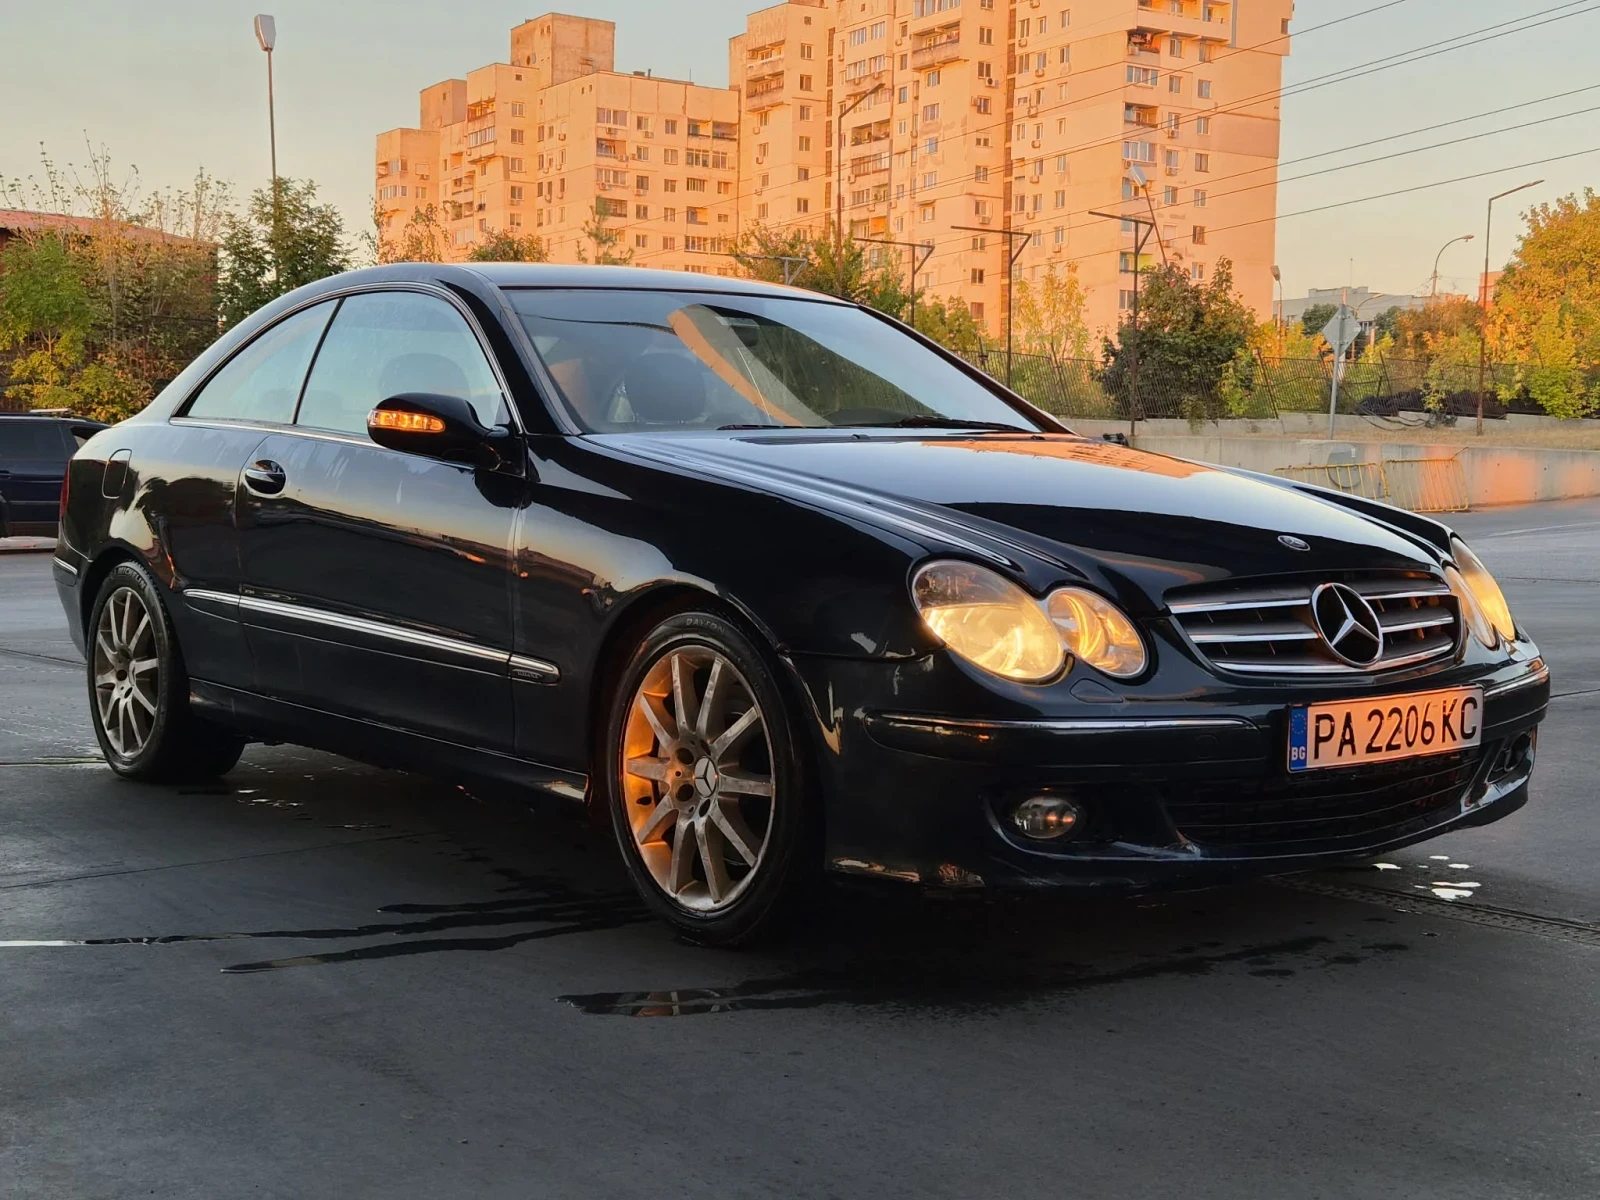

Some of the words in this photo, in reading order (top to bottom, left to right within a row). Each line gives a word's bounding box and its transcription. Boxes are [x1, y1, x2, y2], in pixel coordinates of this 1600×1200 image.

[117, 566, 147, 589] MICHELIN
[686, 618, 725, 633] DAYTON
[1313, 711, 1357, 760] PA
[1365, 701, 1436, 754] 2206
[1441, 696, 1478, 744] KC
[1291, 746, 1306, 761] BG
